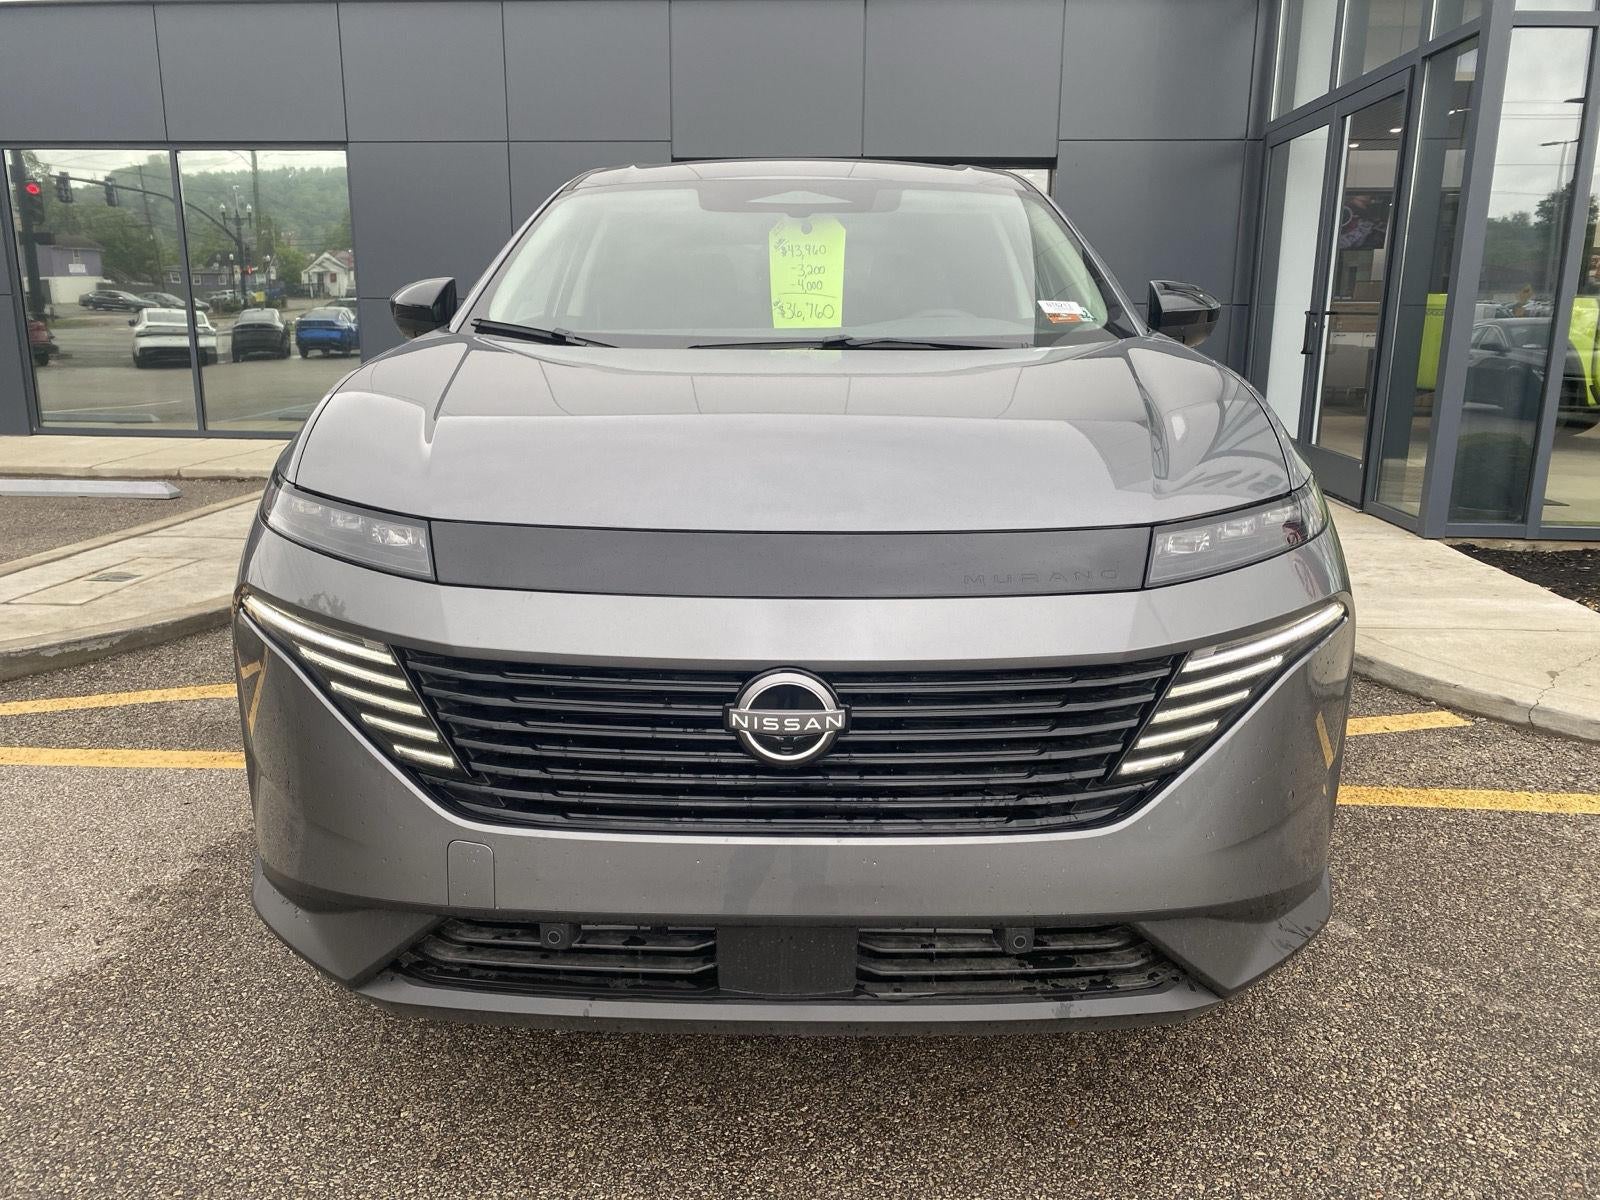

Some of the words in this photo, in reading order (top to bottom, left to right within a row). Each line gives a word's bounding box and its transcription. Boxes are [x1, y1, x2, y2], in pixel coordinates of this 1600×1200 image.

[779, 301, 835, 321] $36,760
[963, 569, 1118, 585] MURANO
[732, 713, 842, 731] NISSAN
